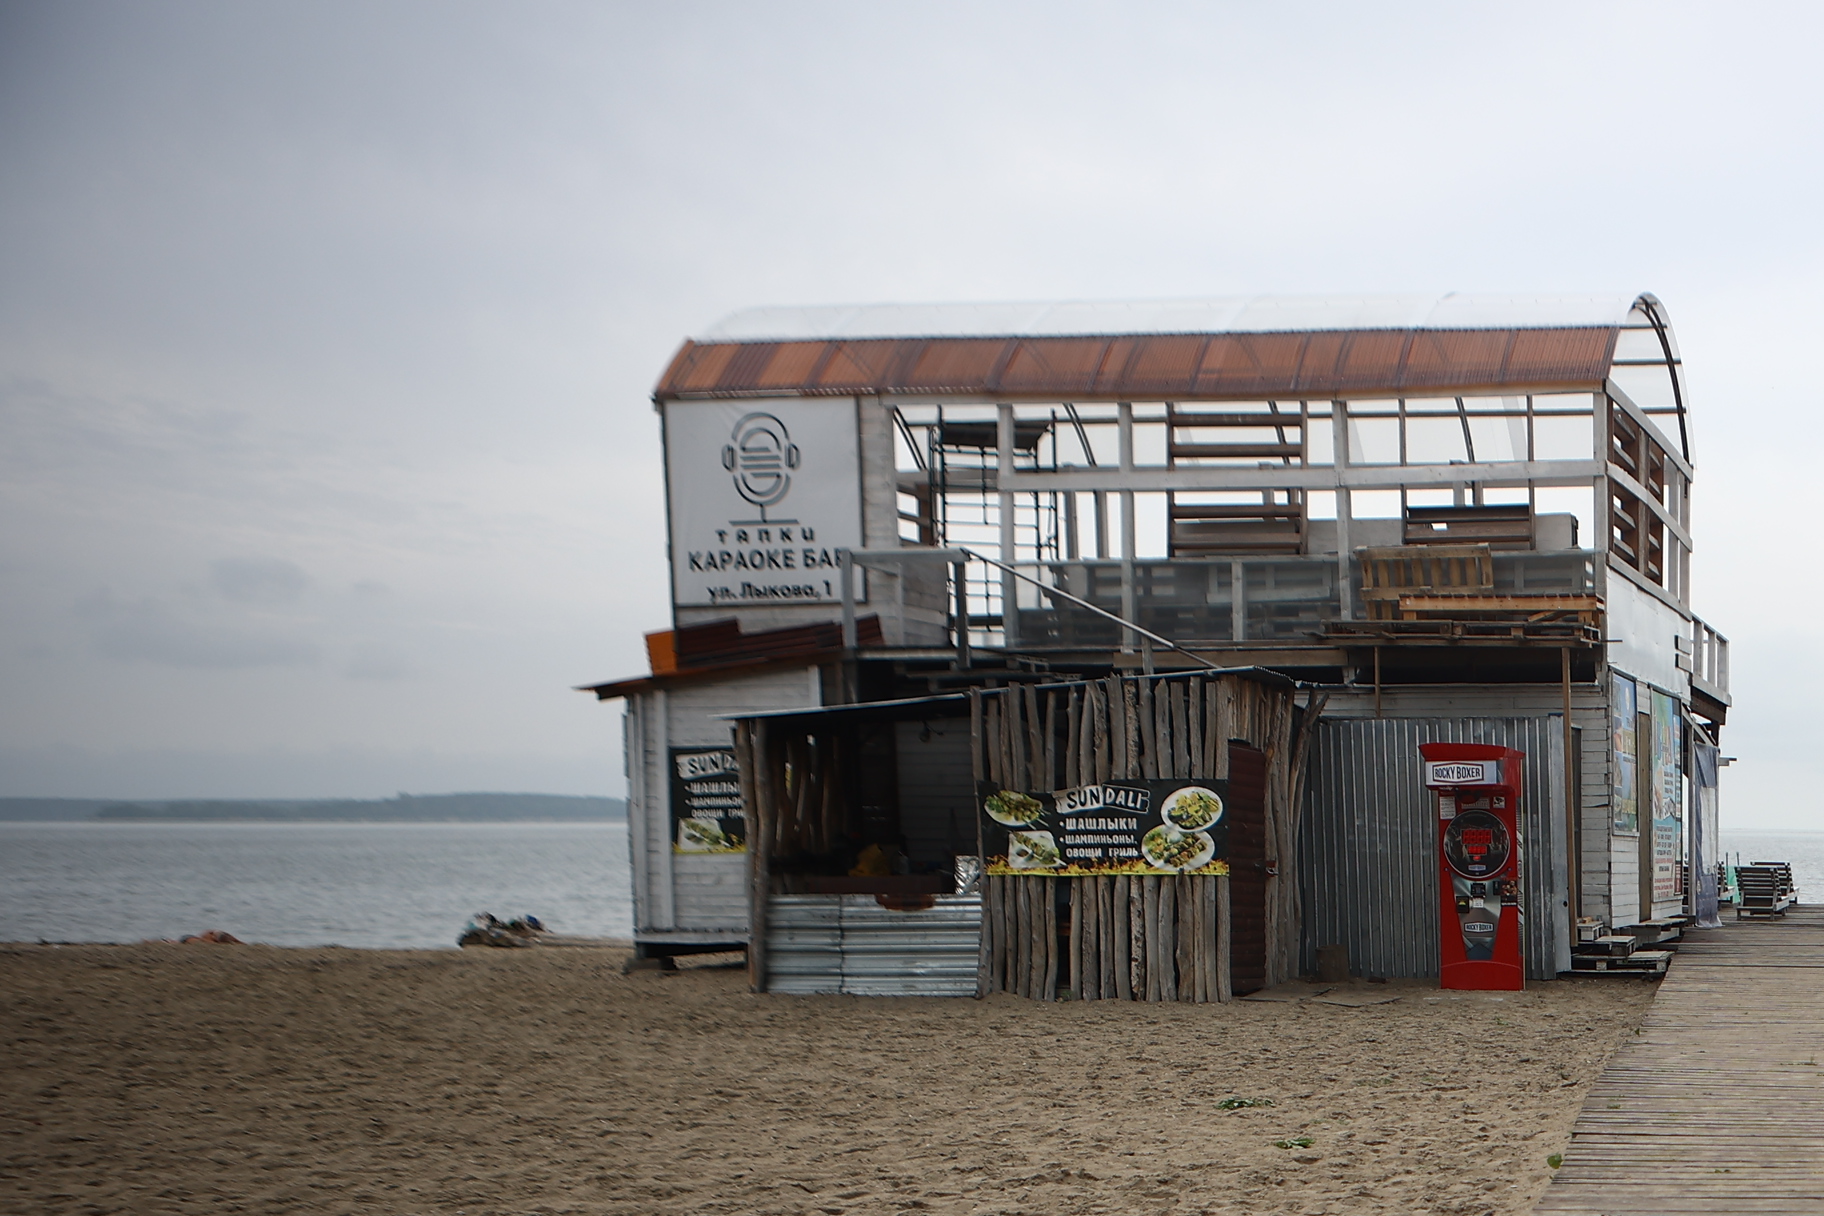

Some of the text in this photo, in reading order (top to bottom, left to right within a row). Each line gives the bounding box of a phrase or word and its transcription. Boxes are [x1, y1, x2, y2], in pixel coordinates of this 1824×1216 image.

[688, 548, 798, 572] КАРАОКЕ
[706, 585, 738, 604] ул.
[739, 581, 822, 601] Лыкова,
[1434, 766, 1481, 780] ROCKY BOXER
[1066, 787, 1142, 810] SUNDALI
[1065, 817, 1137, 830] ШАШЛЫКИ
[1065, 847, 1139, 858] ОВОЩИ ГРИЛЬ
